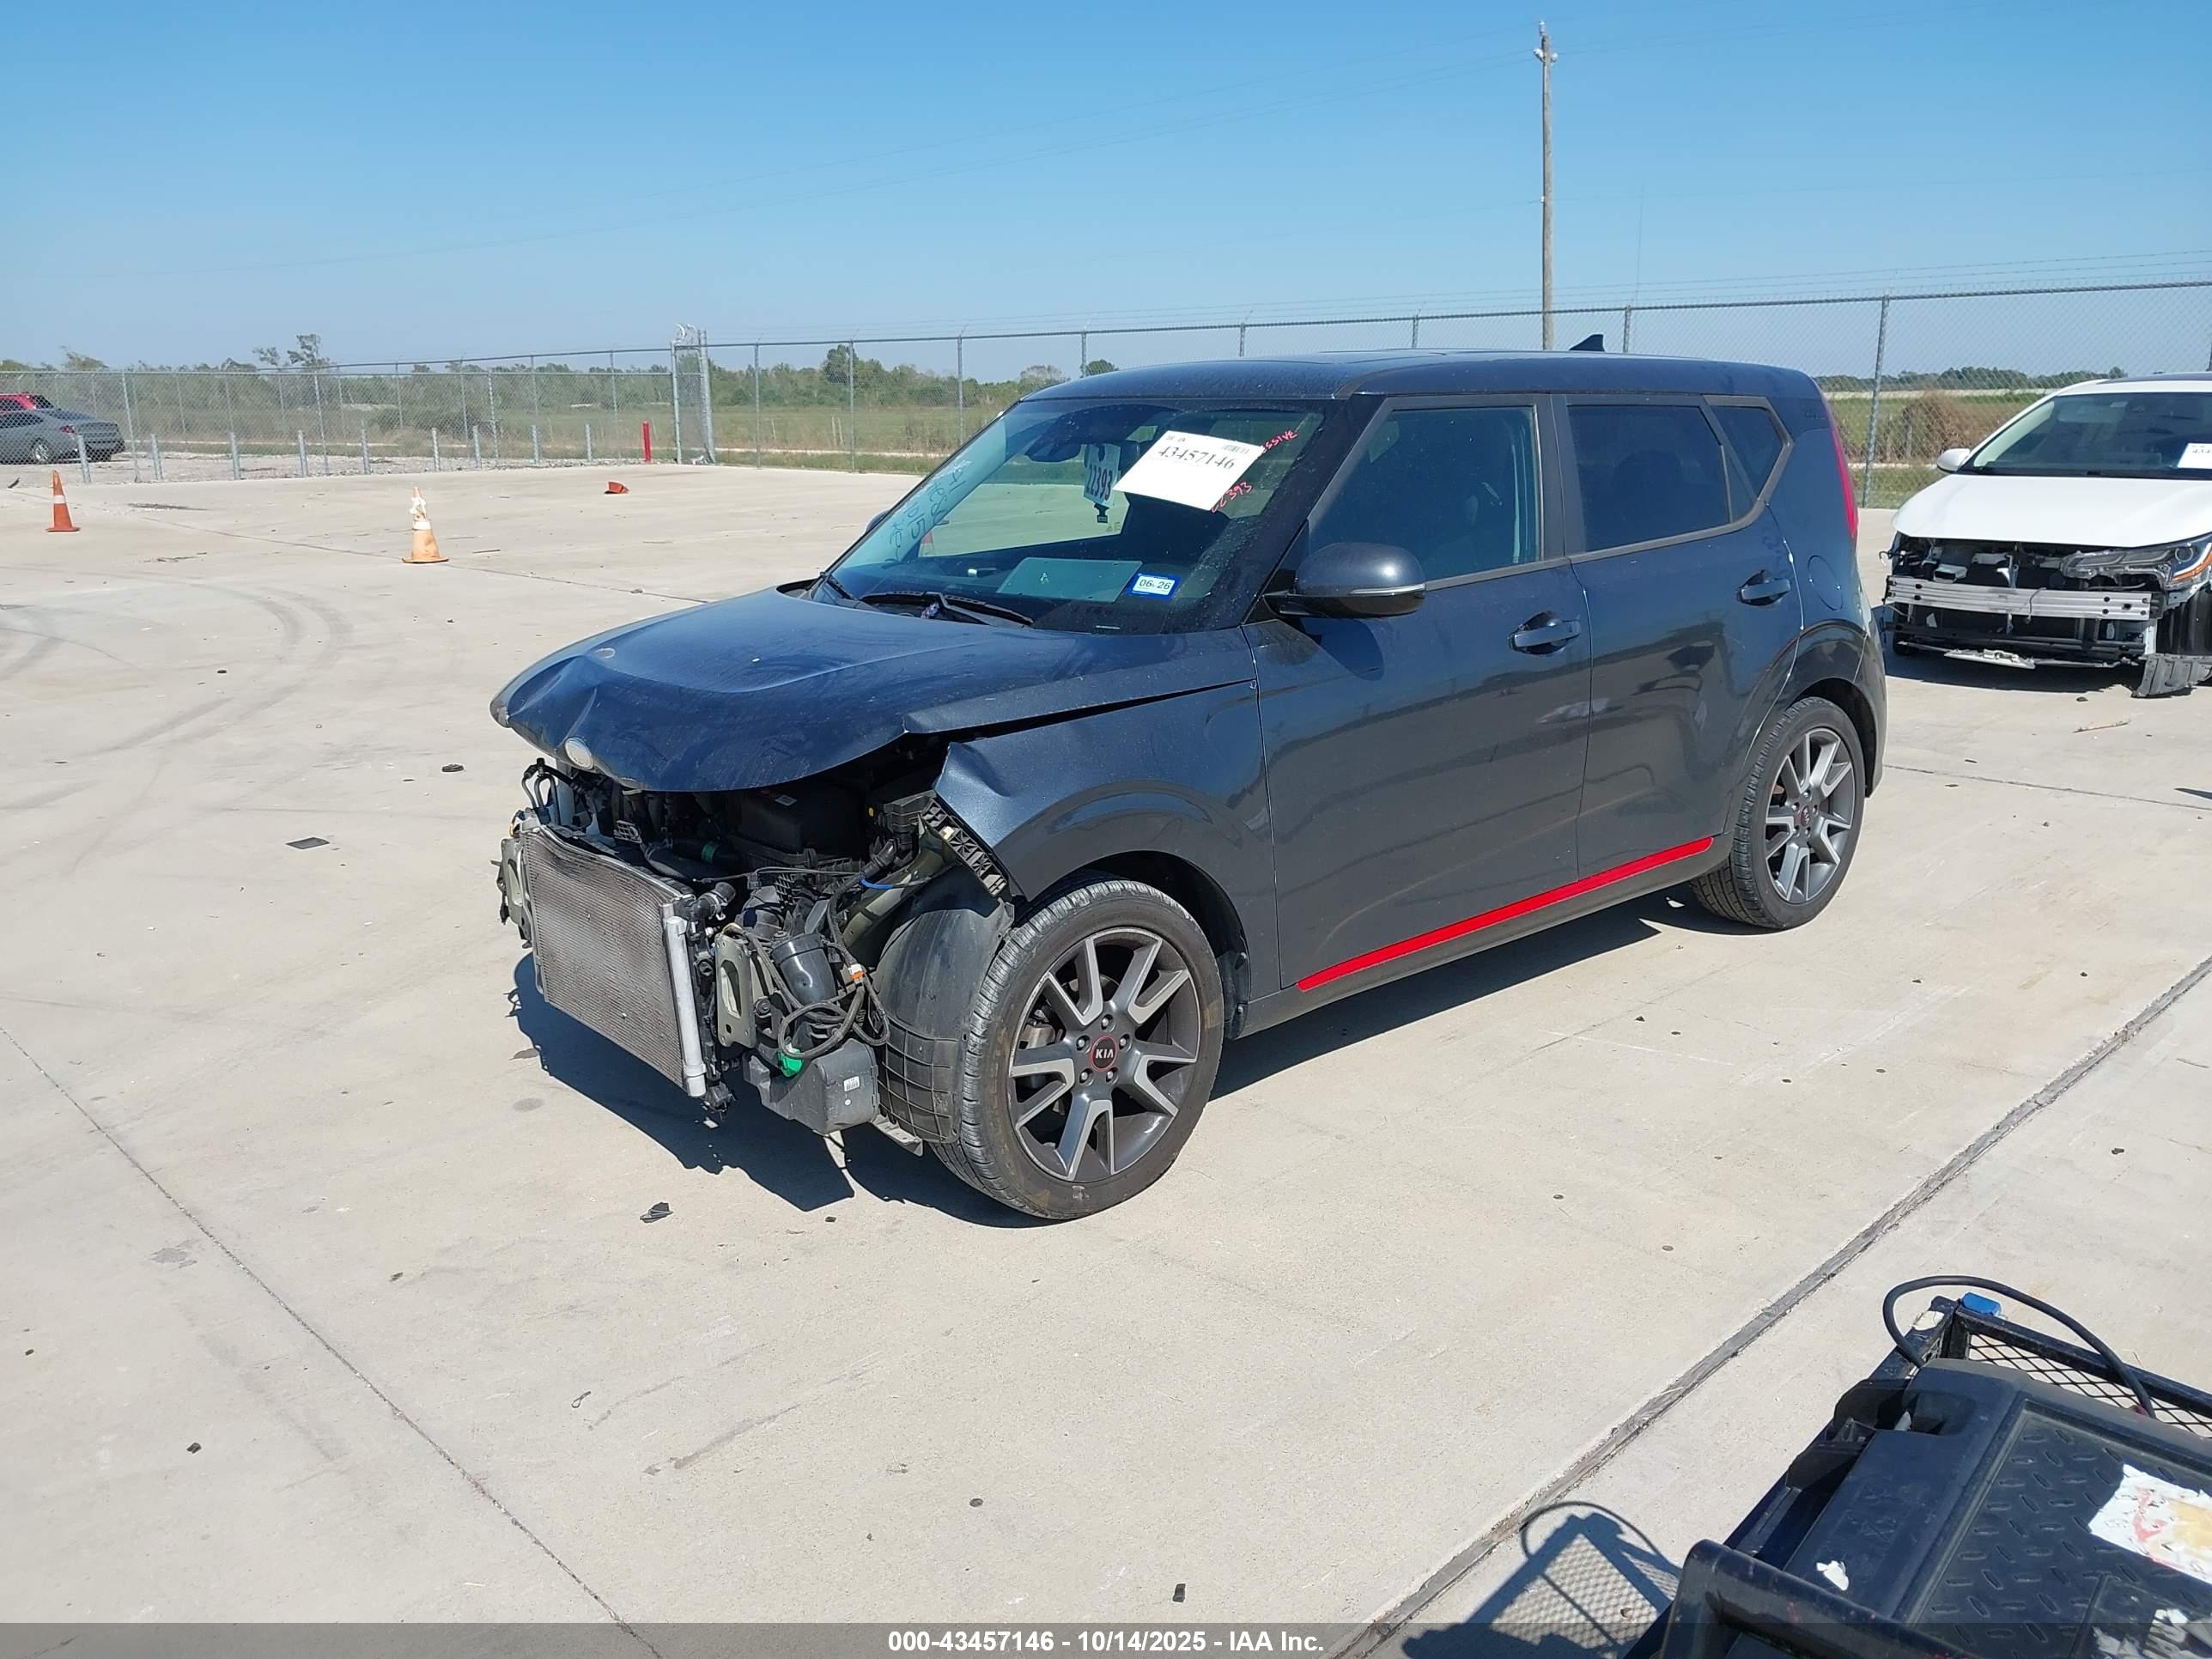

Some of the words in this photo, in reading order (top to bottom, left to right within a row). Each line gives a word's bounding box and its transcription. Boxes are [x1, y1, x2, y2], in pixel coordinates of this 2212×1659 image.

[1158, 447, 1235, 470] 43457146
[1139, 579, 1154, 587] 06
[1156, 580, 1172, 590] 26
[1095, 1048, 1114, 1059] KIA
